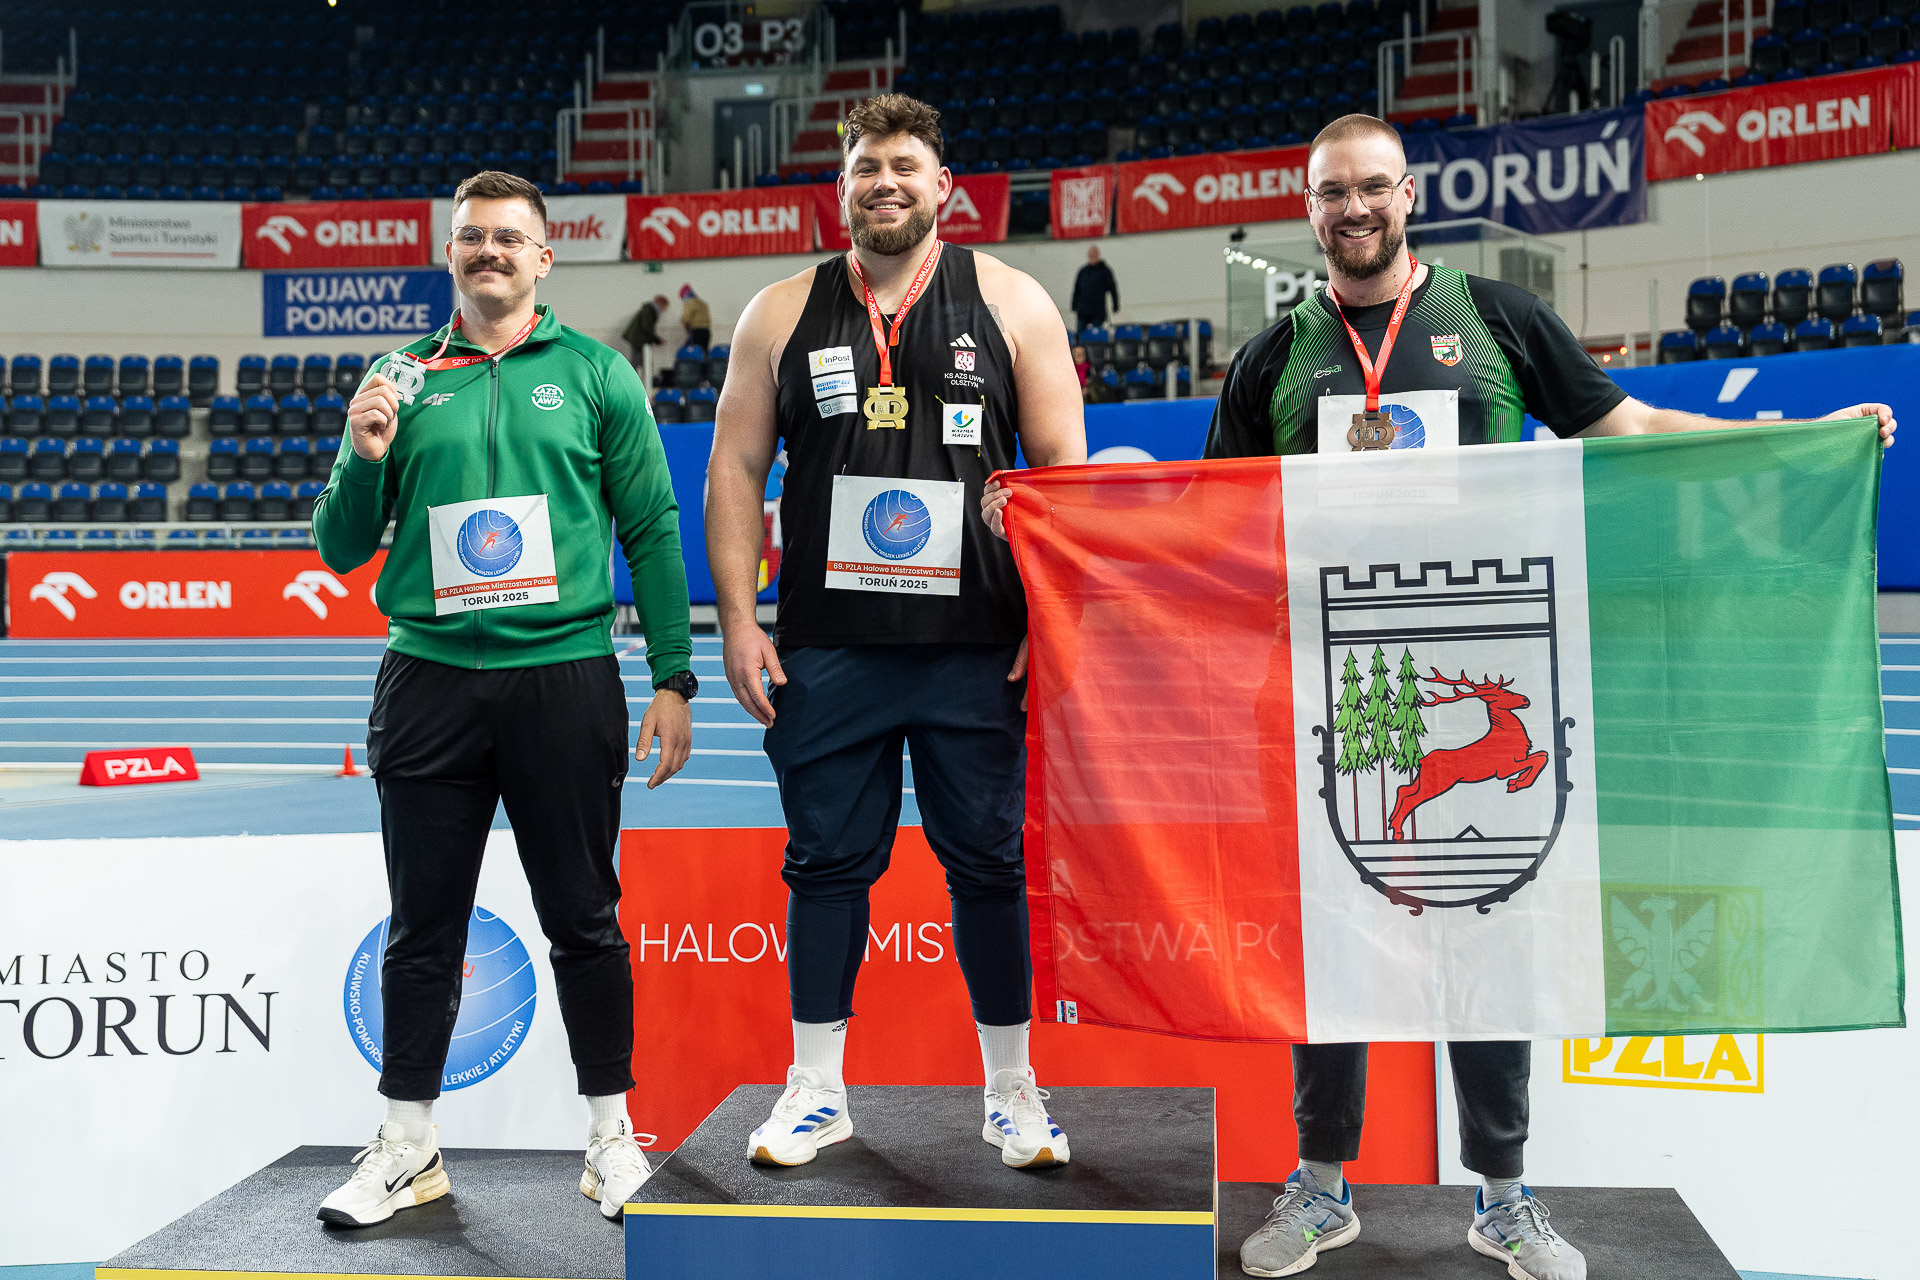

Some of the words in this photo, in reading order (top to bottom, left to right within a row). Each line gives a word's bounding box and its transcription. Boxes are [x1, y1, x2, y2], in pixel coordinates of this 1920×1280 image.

[760, 17, 805, 53] P3
[1736, 95, 1870, 142] ORLEN
[1413, 120, 1631, 213] TORUŃ
[1194, 167, 1305, 203] ORLEN
[109, 216, 191, 229] Ministerstwo
[315, 218, 418, 247] ORLEN
[699, 206, 799, 237] ORLEN
[110, 232, 153, 245] Sportu
[162, 232, 218, 246] Turystyki
[286, 276, 407, 302] KUJAWY
[286, 305, 431, 332] POMORZE
[452, 358, 471, 366] 2025
[825, 355, 850, 364] InPost
[951, 380, 979, 388] OLSZTYN
[968, 374, 985, 384] UWM
[845, 563, 862, 571] PZLA
[863, 564, 889, 573] Halowe
[890, 564, 934, 576] Mistrzostwa
[935, 568, 957, 577] Polski
[858, 576, 897, 588] TORUŃ
[899, 579, 928, 589] 2025
[119, 580, 232, 610] ORLEN
[449, 587, 463, 595] PZLA
[464, 584, 490, 593] Halowe
[491, 580, 532, 590] Mistrzostwa
[533, 577, 553, 586] Polski
[461, 592, 500, 607] TORUŃ
[502, 591, 529, 602] 2025
[104, 755, 187, 780] PZLA
[444, 1061, 490, 1086] LEKKIEJ
[489, 1020, 525, 1067] ATLETYKI
[1573, 1034, 1752, 1081] PZLA
